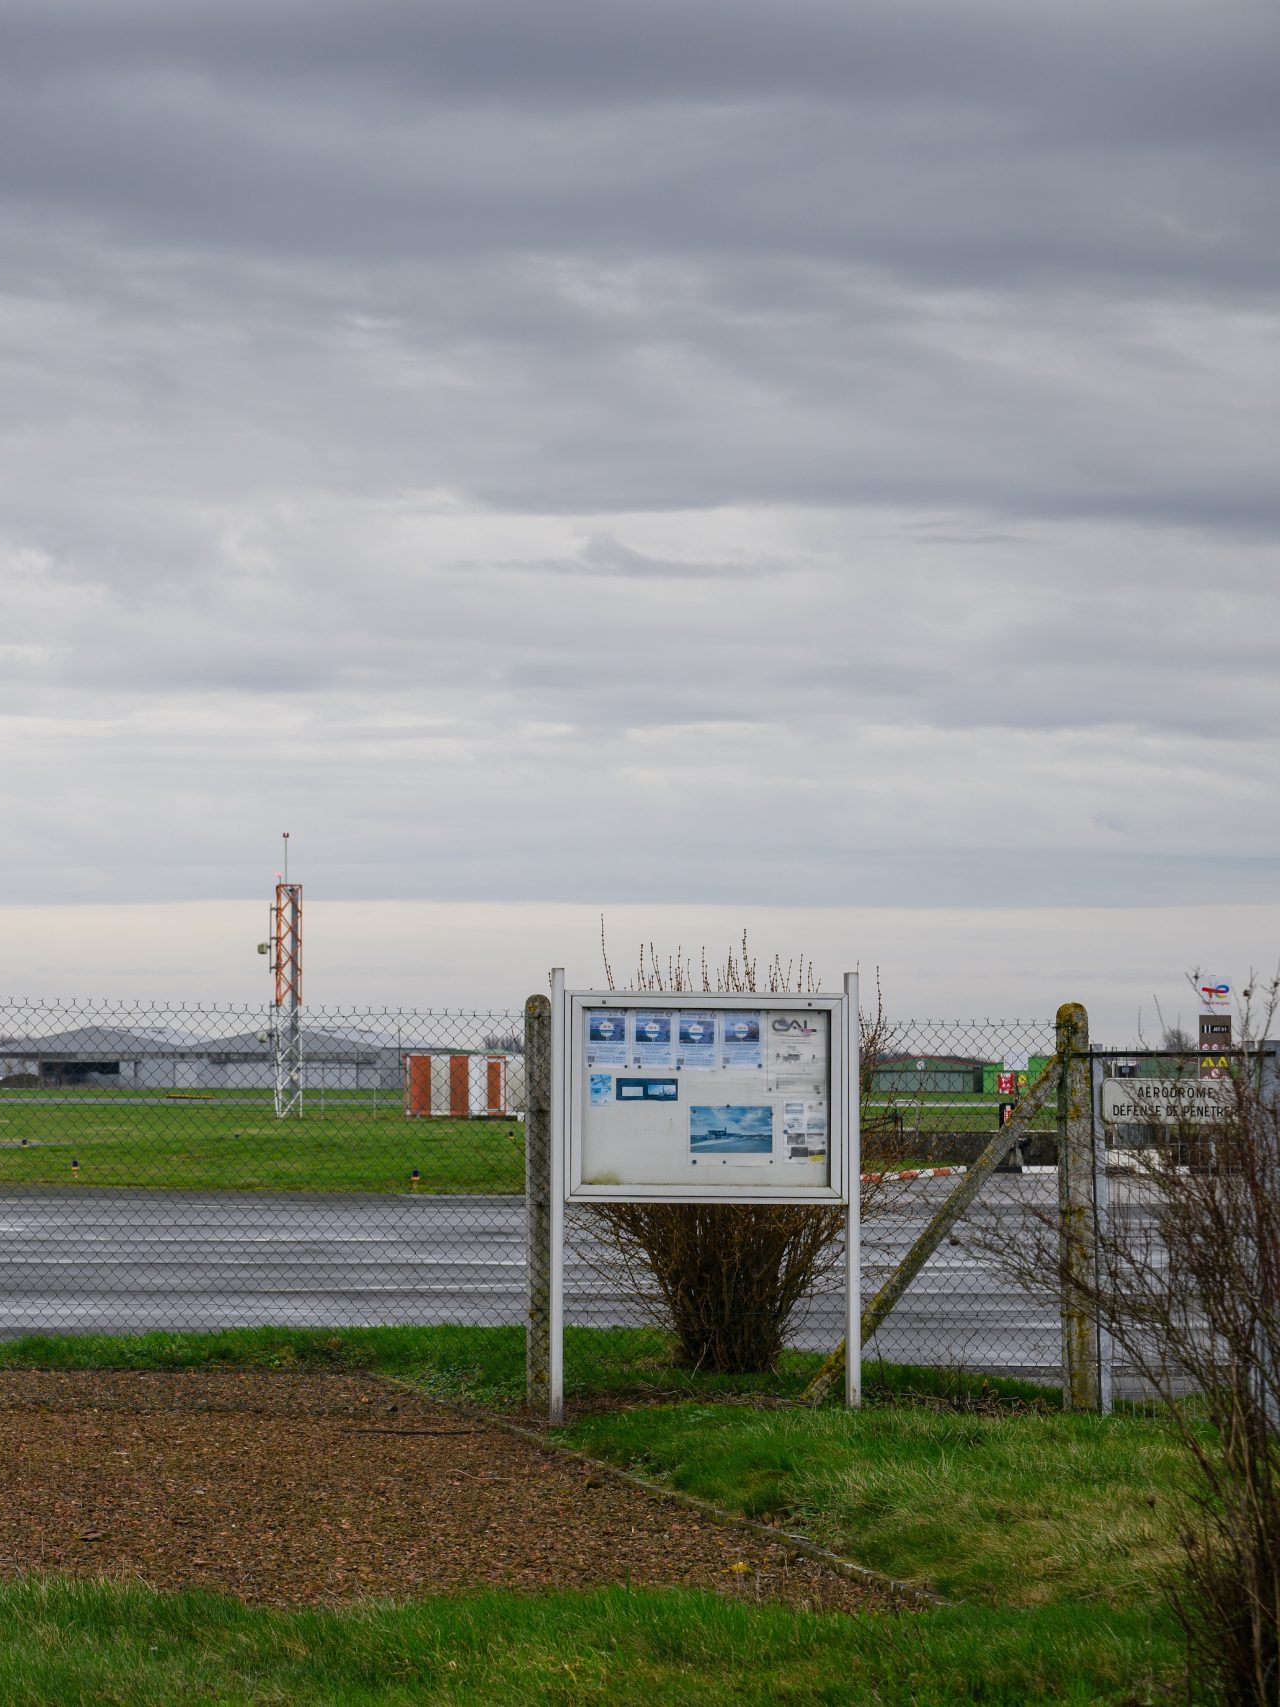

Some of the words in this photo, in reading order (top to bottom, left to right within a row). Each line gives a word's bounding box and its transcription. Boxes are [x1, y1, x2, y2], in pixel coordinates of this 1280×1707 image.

[1137, 1085, 1214, 1098] AÉRODROME
[1113, 1103, 1162, 1117] DÉFENSE
[1166, 1105, 1178, 1117] DE
[1183, 1103, 1236, 1117] PÉNÉTR
